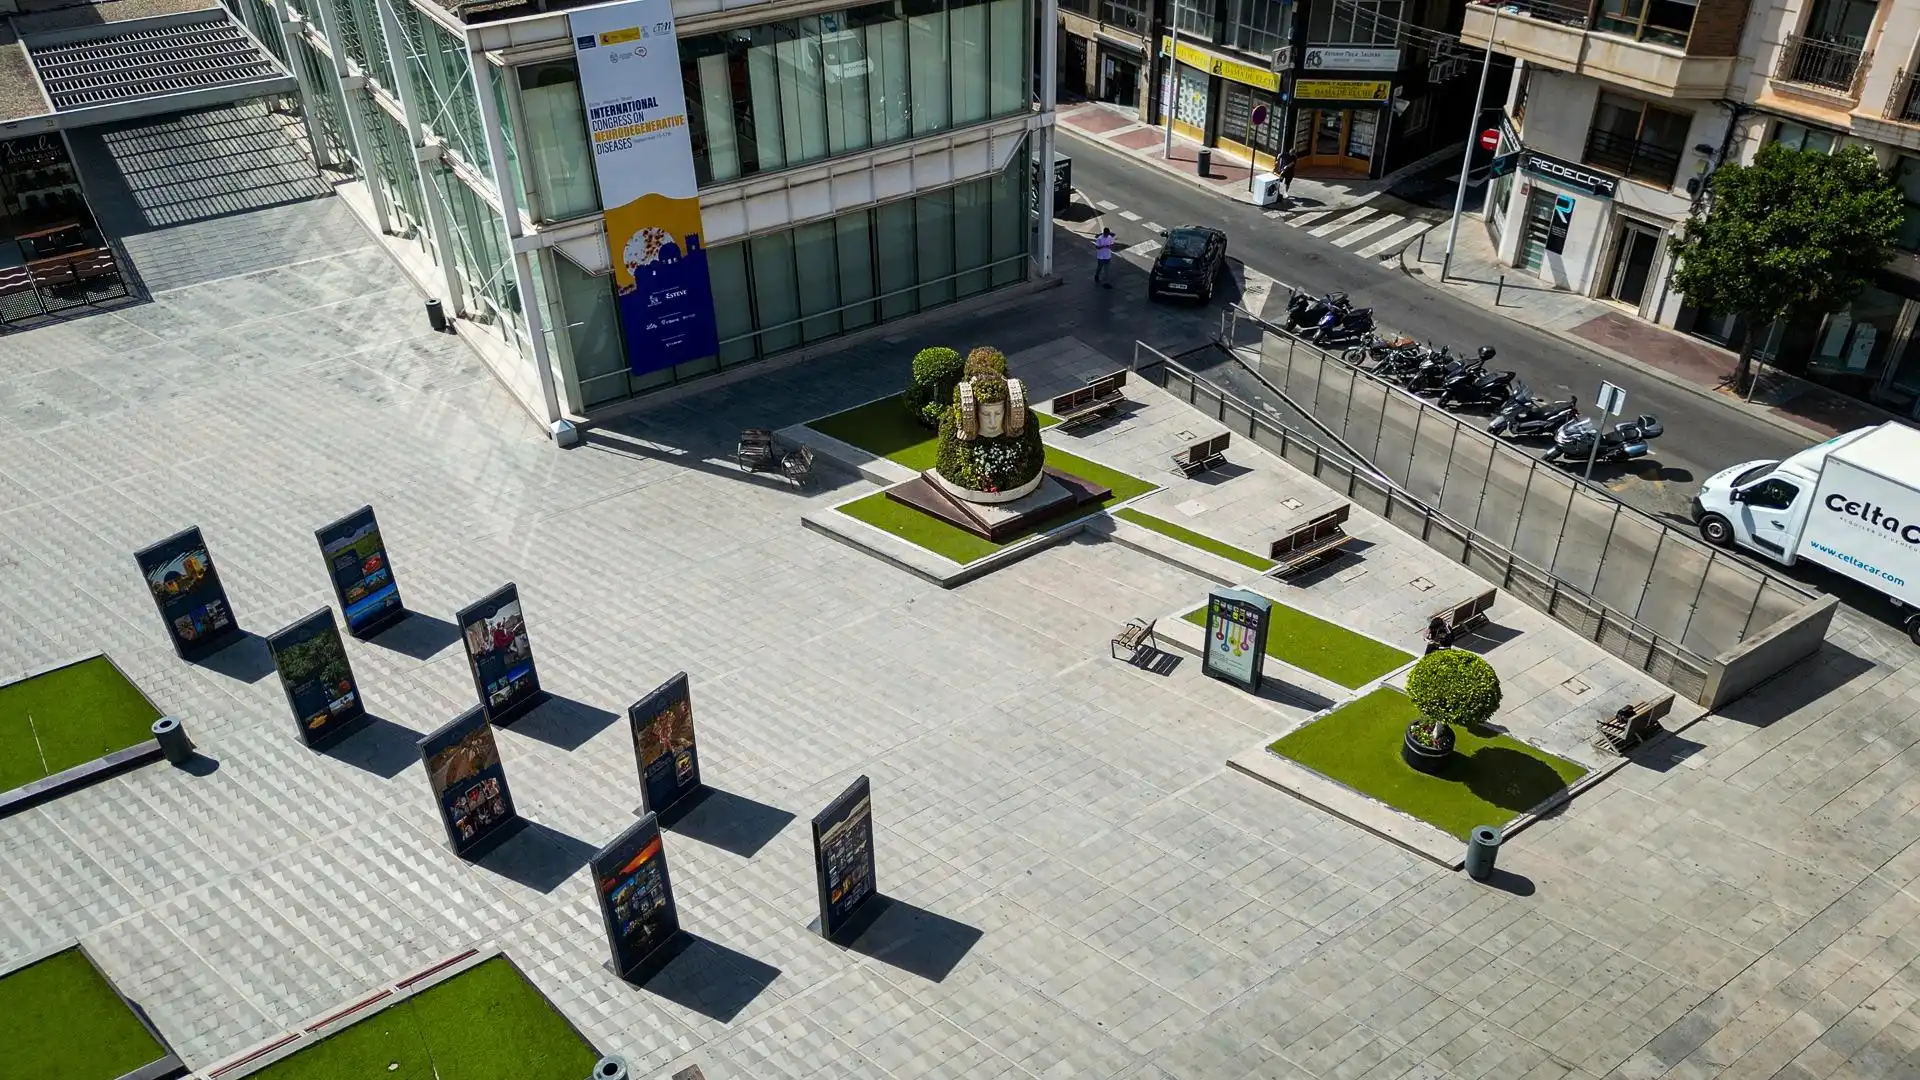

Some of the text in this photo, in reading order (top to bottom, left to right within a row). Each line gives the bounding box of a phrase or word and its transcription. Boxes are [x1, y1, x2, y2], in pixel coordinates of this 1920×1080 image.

[590, 97, 658, 119] INTERNATIONAL
[592, 111, 645, 131] CONGRESS ON
[594, 115, 685, 143] NEURODEGENERATIVE
[597, 138, 632, 155] DISEASES
[1528, 156, 1614, 192] REDECOR
[1810, 540, 1905, 587] www.celtacar.com
